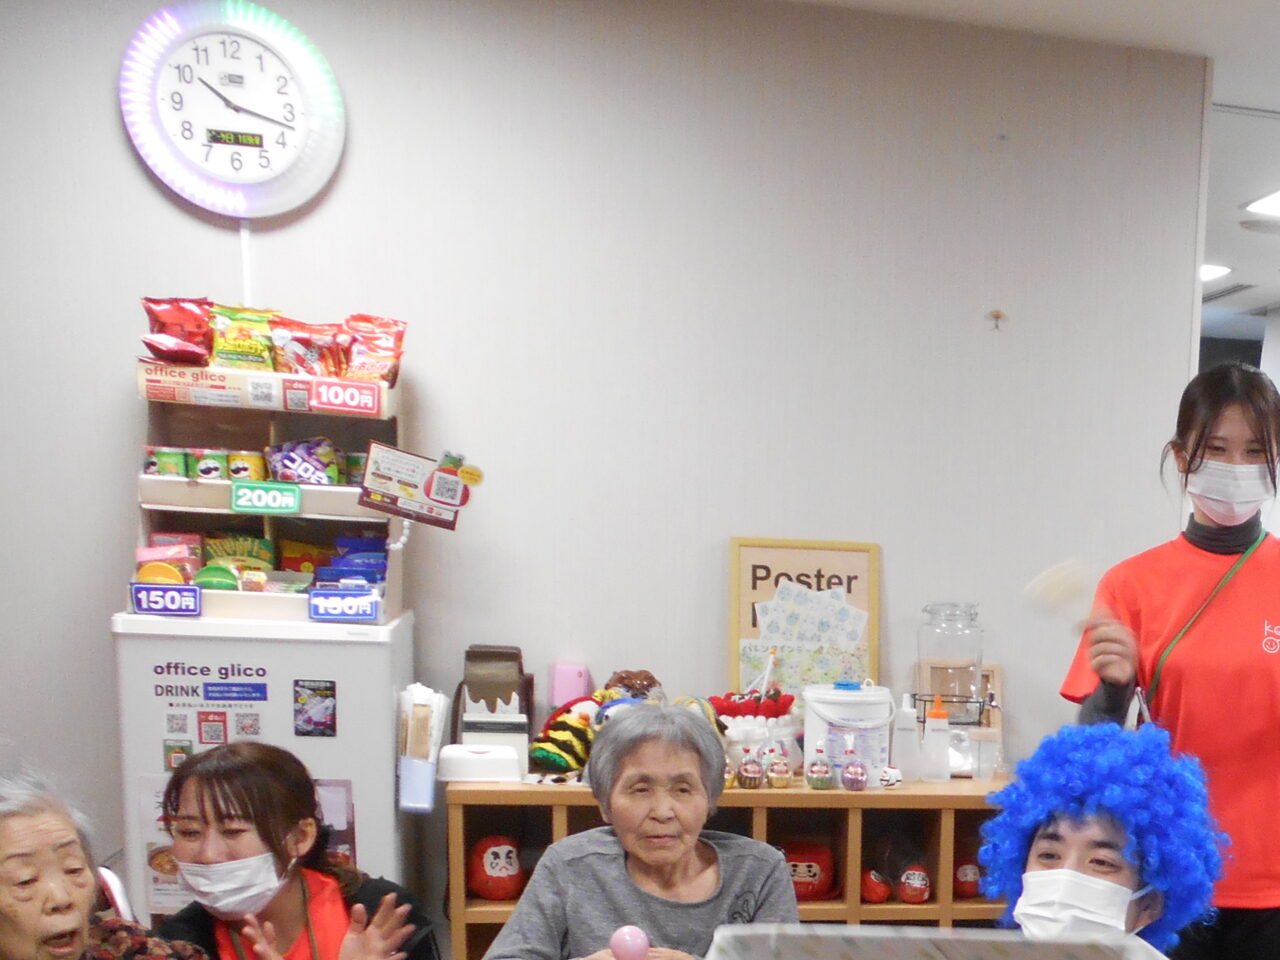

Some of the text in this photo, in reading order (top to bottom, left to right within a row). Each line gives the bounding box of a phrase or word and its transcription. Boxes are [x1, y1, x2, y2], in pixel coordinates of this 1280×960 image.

[193, 46, 210, 65] 11
[219, 40, 241, 59] 12
[256, 54, 264, 72] 1
[174, 64, 194, 84] 10
[276, 76, 288, 95] 2
[170, 92, 184, 111] 9
[282, 103, 296, 122] 3
[181, 121, 194, 140] 8
[275, 131, 287, 149] 4
[202, 144, 213, 163] 7
[230, 151, 243, 171] 6
[258, 150, 270, 168] 5
[145, 366, 226, 382] office glico
[317, 385, 373, 408] 100円
[236, 488, 295, 508] 200円
[752, 564, 858, 594] Poster
[137, 590, 195, 610] 150円
[153, 662, 267, 680] office glico
[154, 684, 200, 697] DRINK
